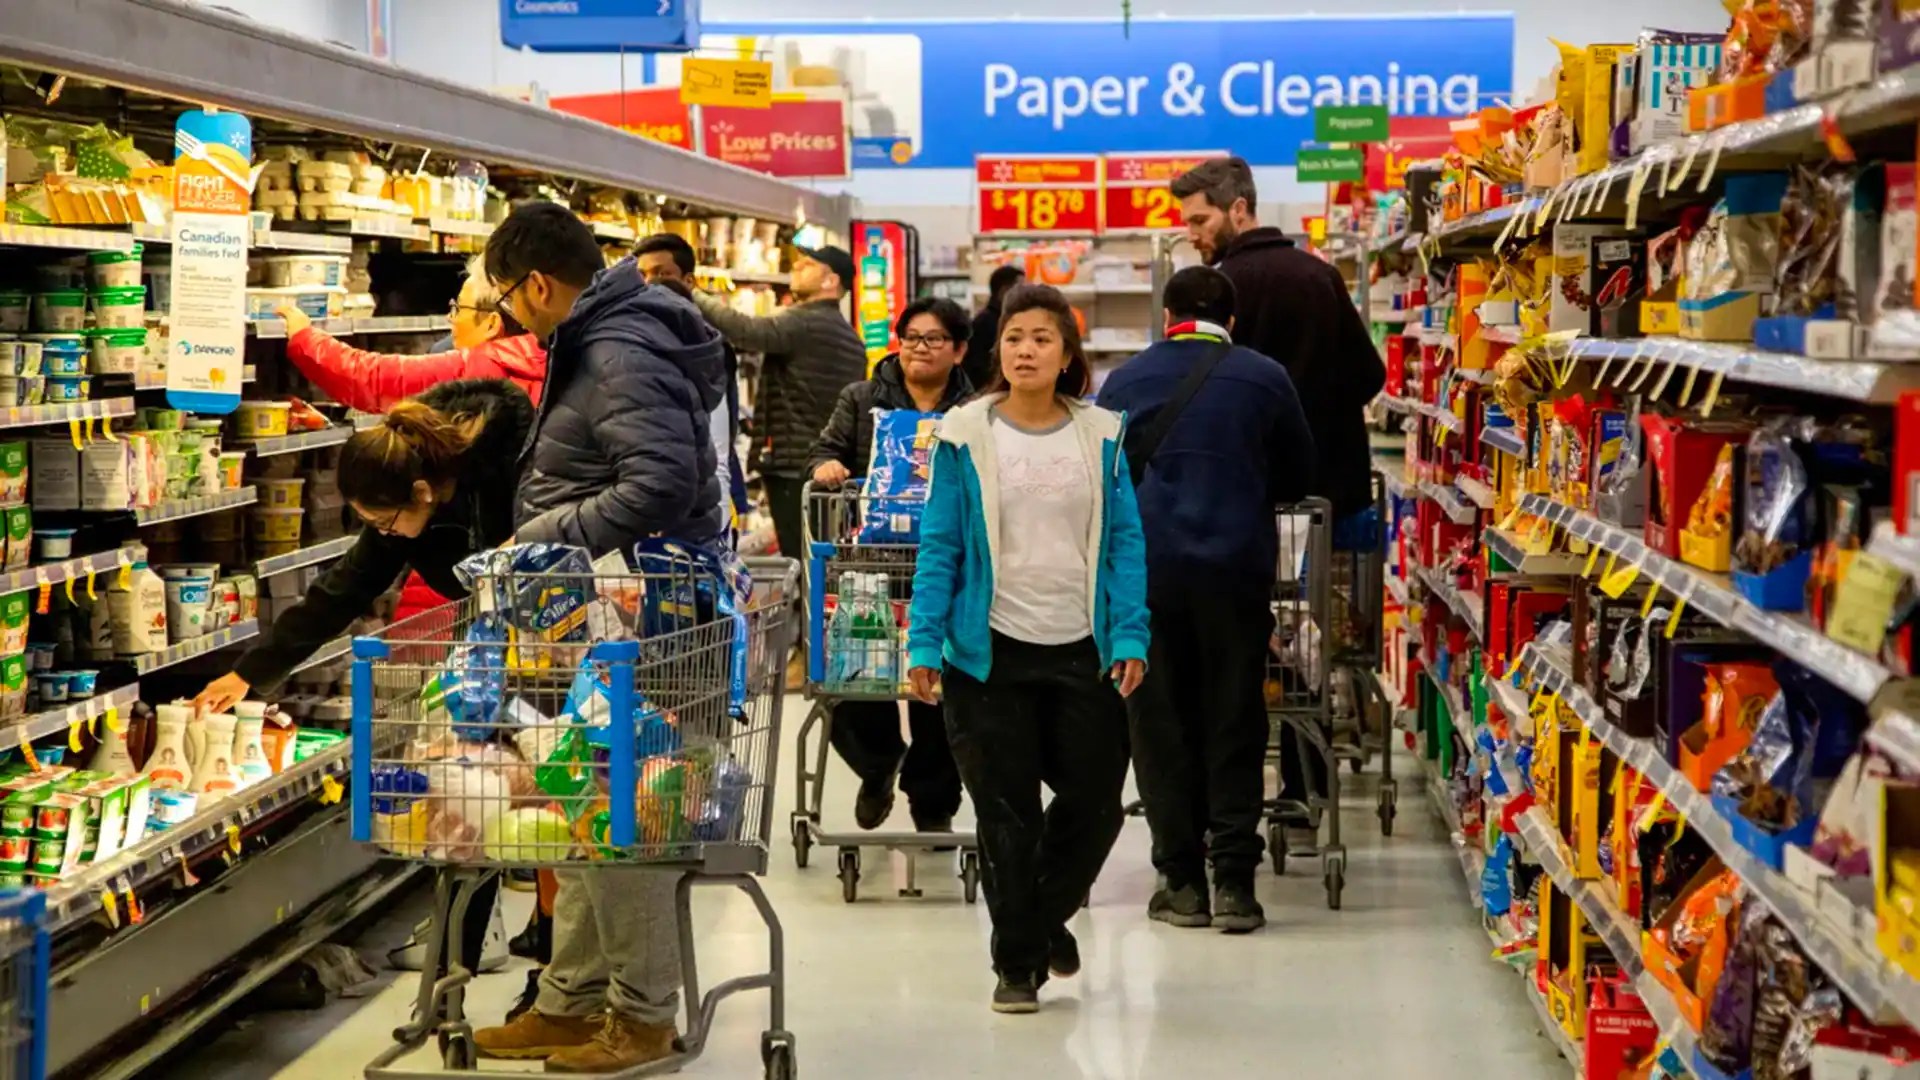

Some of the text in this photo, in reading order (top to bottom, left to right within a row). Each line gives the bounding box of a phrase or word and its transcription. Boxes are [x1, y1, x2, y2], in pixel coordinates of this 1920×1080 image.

[514, 0, 580, 14] Cosmetics
[984, 59, 1479, 130] Paper & Cleaning
[1329, 117, 1373, 129] Popcorn
[619, 122, 683, 142] ices
[719, 133, 767, 153] Low
[769, 131, 836, 152] Prices
[179, 174, 225, 190] FIGHT
[179, 228, 241, 245] Canadian
[178, 245, 240, 259] families fed
